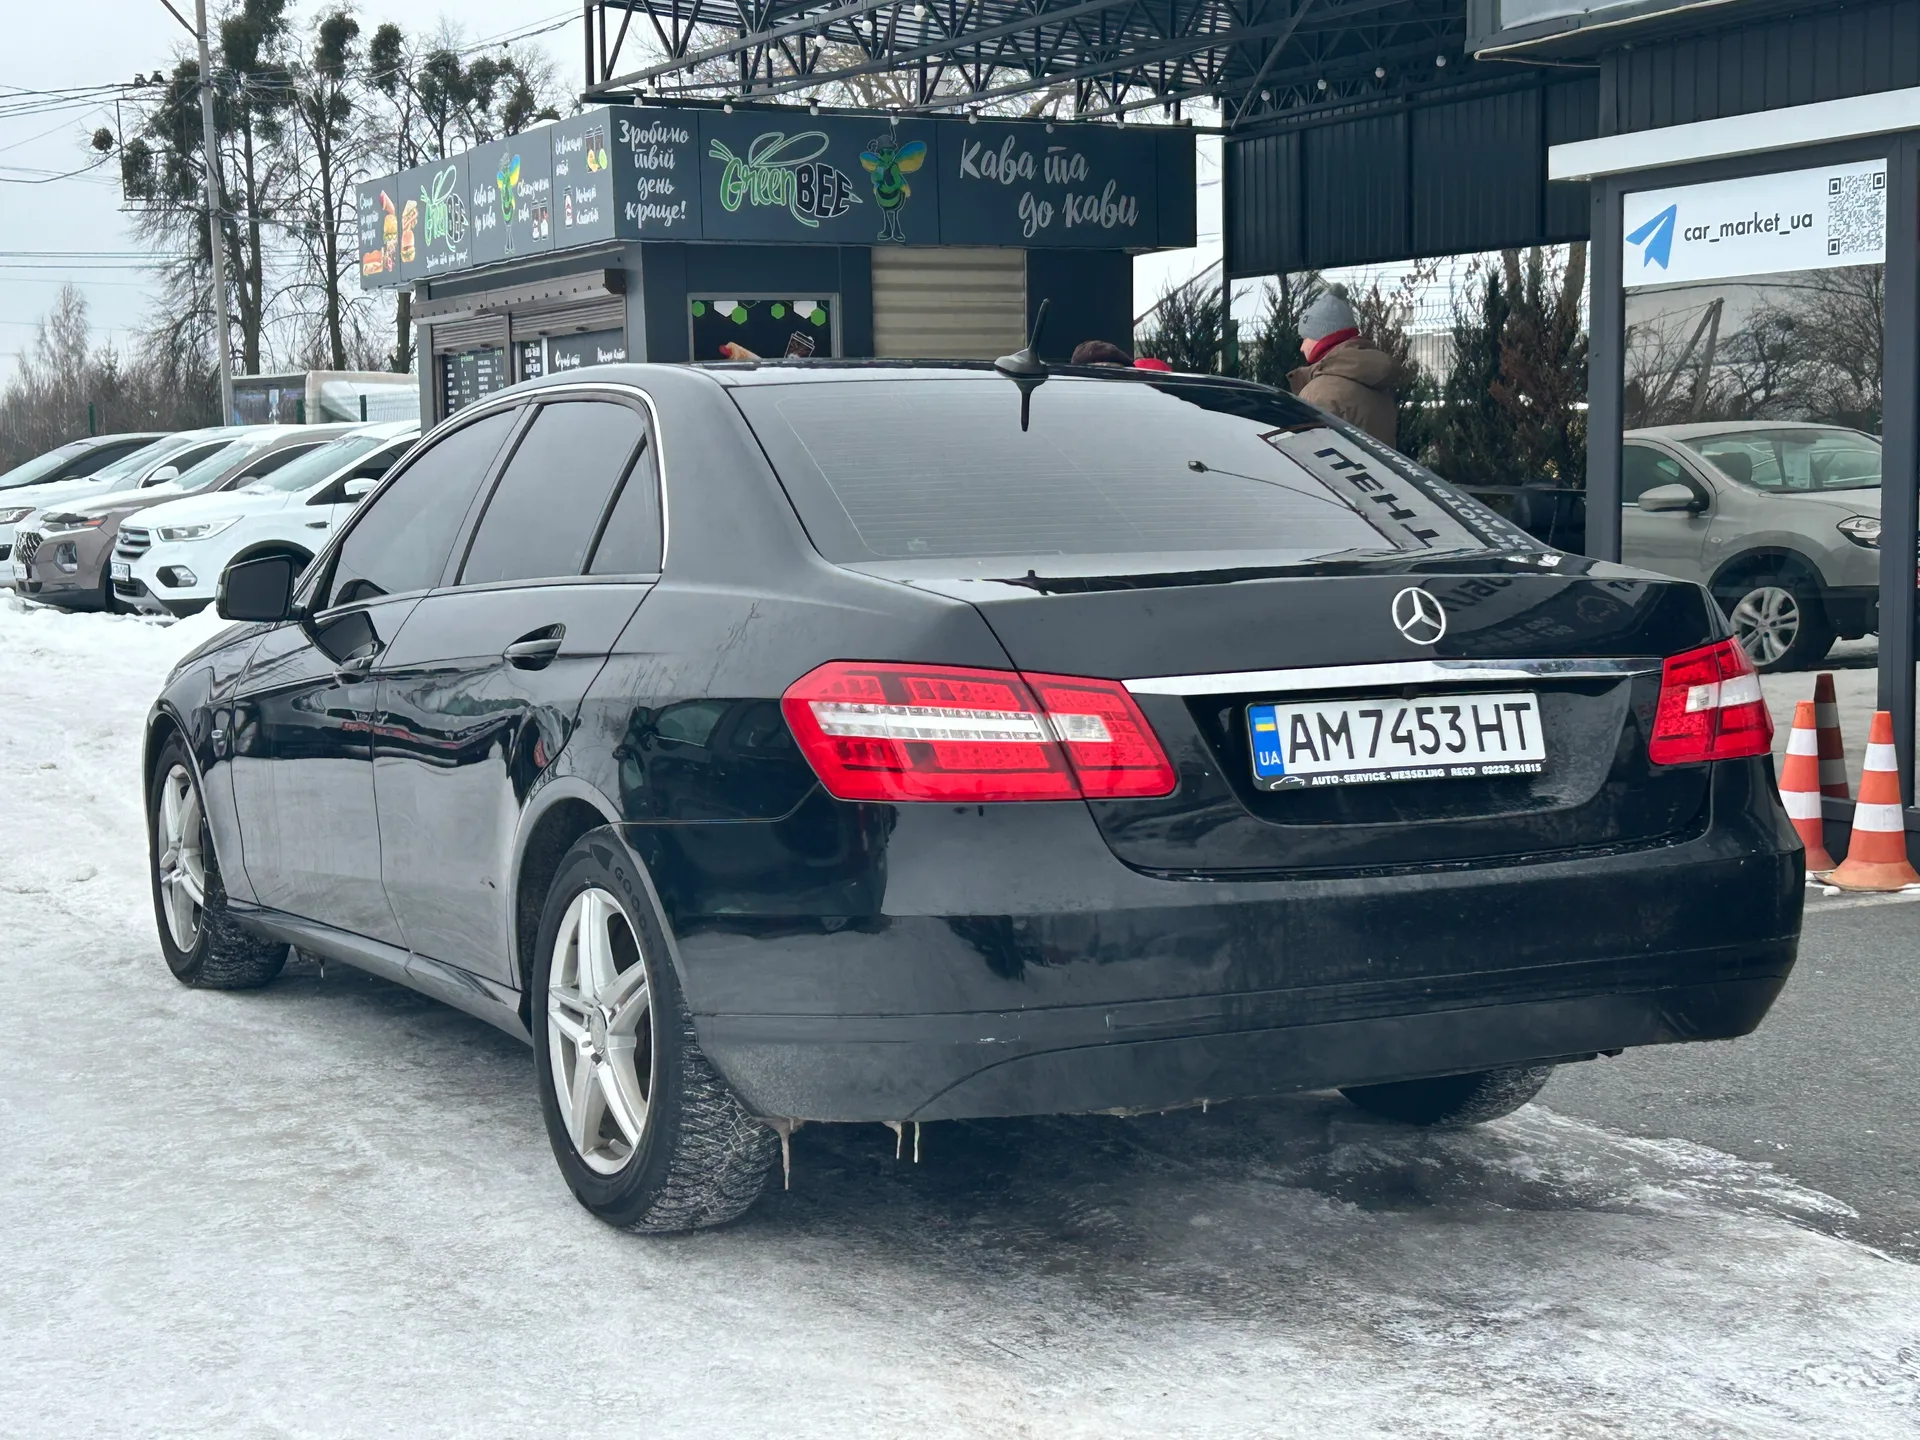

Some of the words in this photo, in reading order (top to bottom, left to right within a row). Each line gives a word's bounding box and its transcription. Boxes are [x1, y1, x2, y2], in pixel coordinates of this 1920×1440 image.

[634, 144, 676, 171] твій
[959, 134, 1037, 188] Кава
[1043, 146, 1090, 183] та
[637, 177, 676, 198] день
[624, 199, 688, 231] краще!
[1017, 179, 1055, 238] до
[1062, 180, 1140, 229] кави
[1684, 211, 1813, 243] car_market_ua
[1259, 750, 1281, 767] UA
